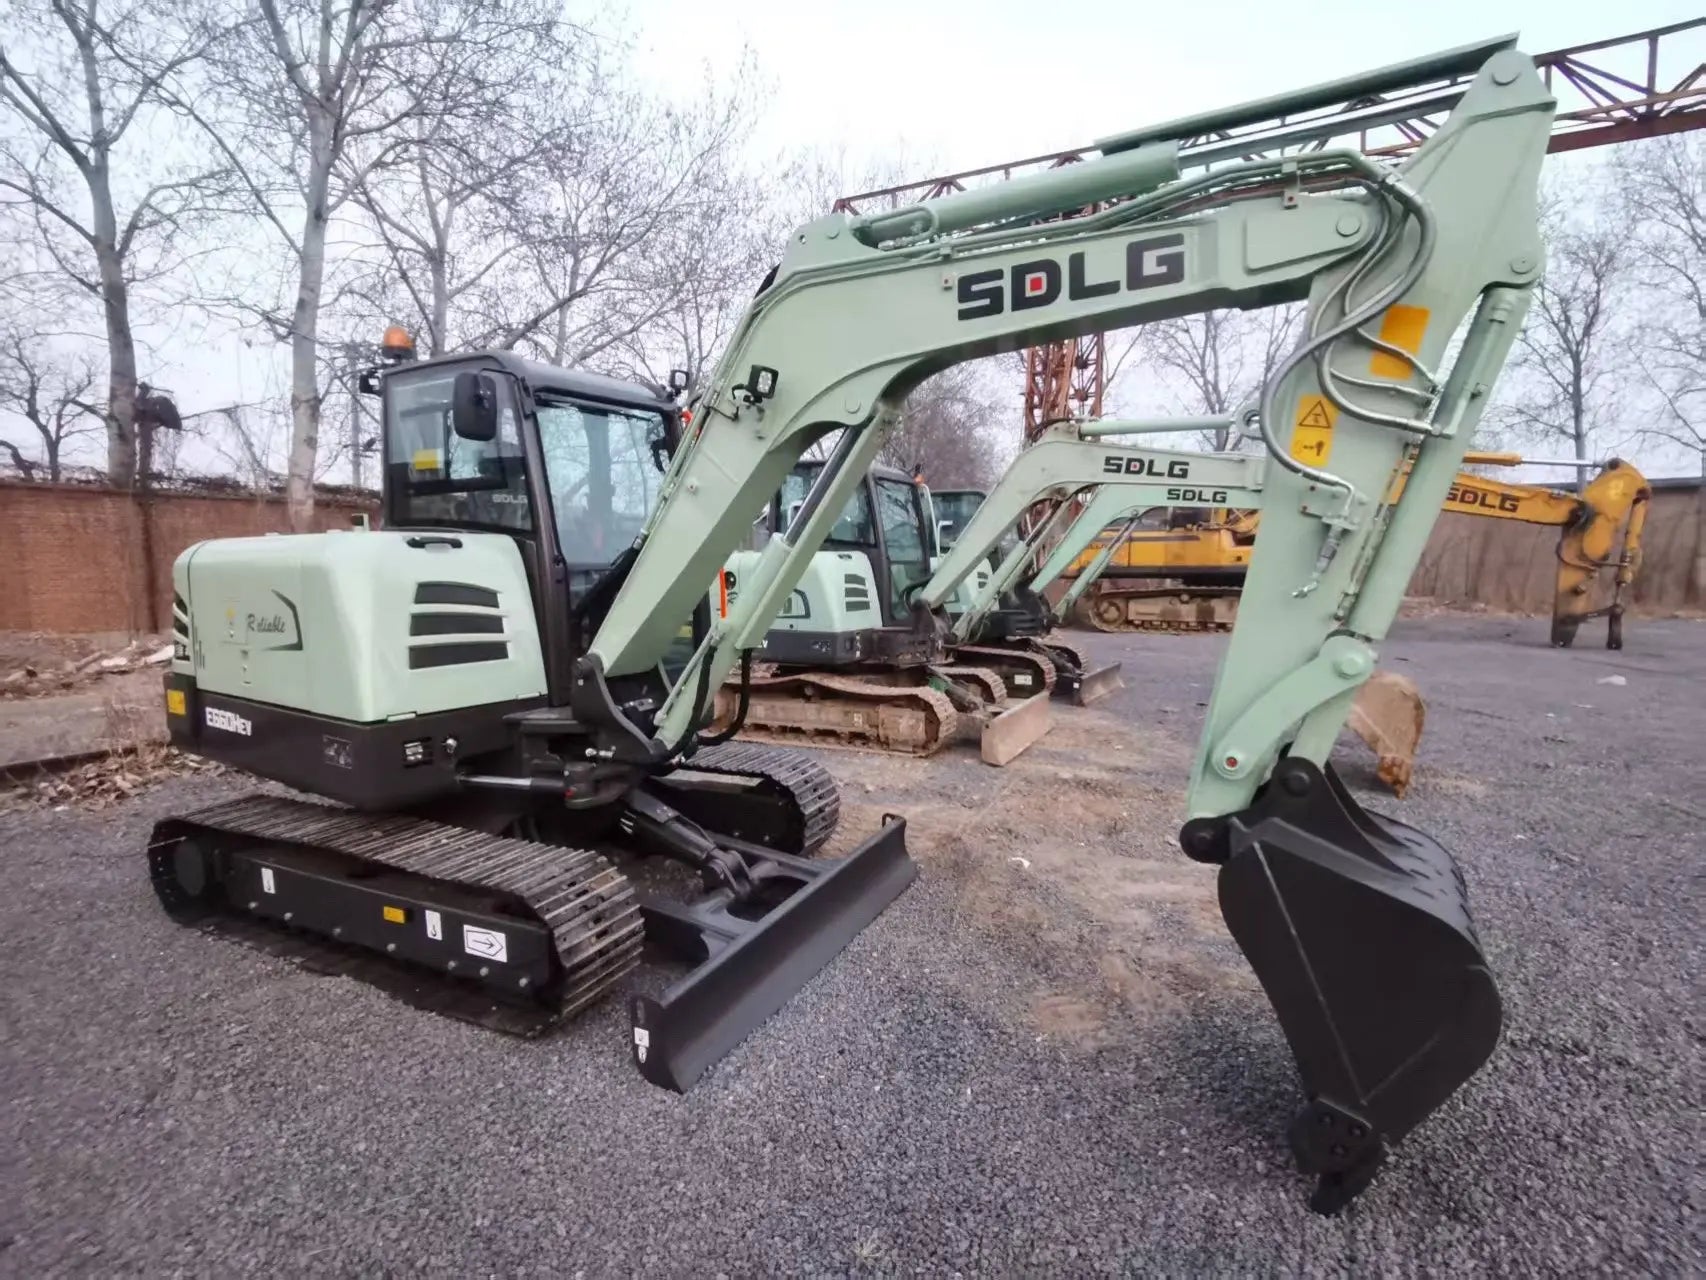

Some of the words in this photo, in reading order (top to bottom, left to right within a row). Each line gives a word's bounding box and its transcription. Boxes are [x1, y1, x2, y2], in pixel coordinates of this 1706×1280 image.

[958, 233, 1185, 320] SDLG
[1103, 456, 1189, 479] SDLG
[1167, 488, 1227, 504] SDLG
[1446, 487, 1520, 512] SDLG
[247, 613, 286, 633] Reliable
